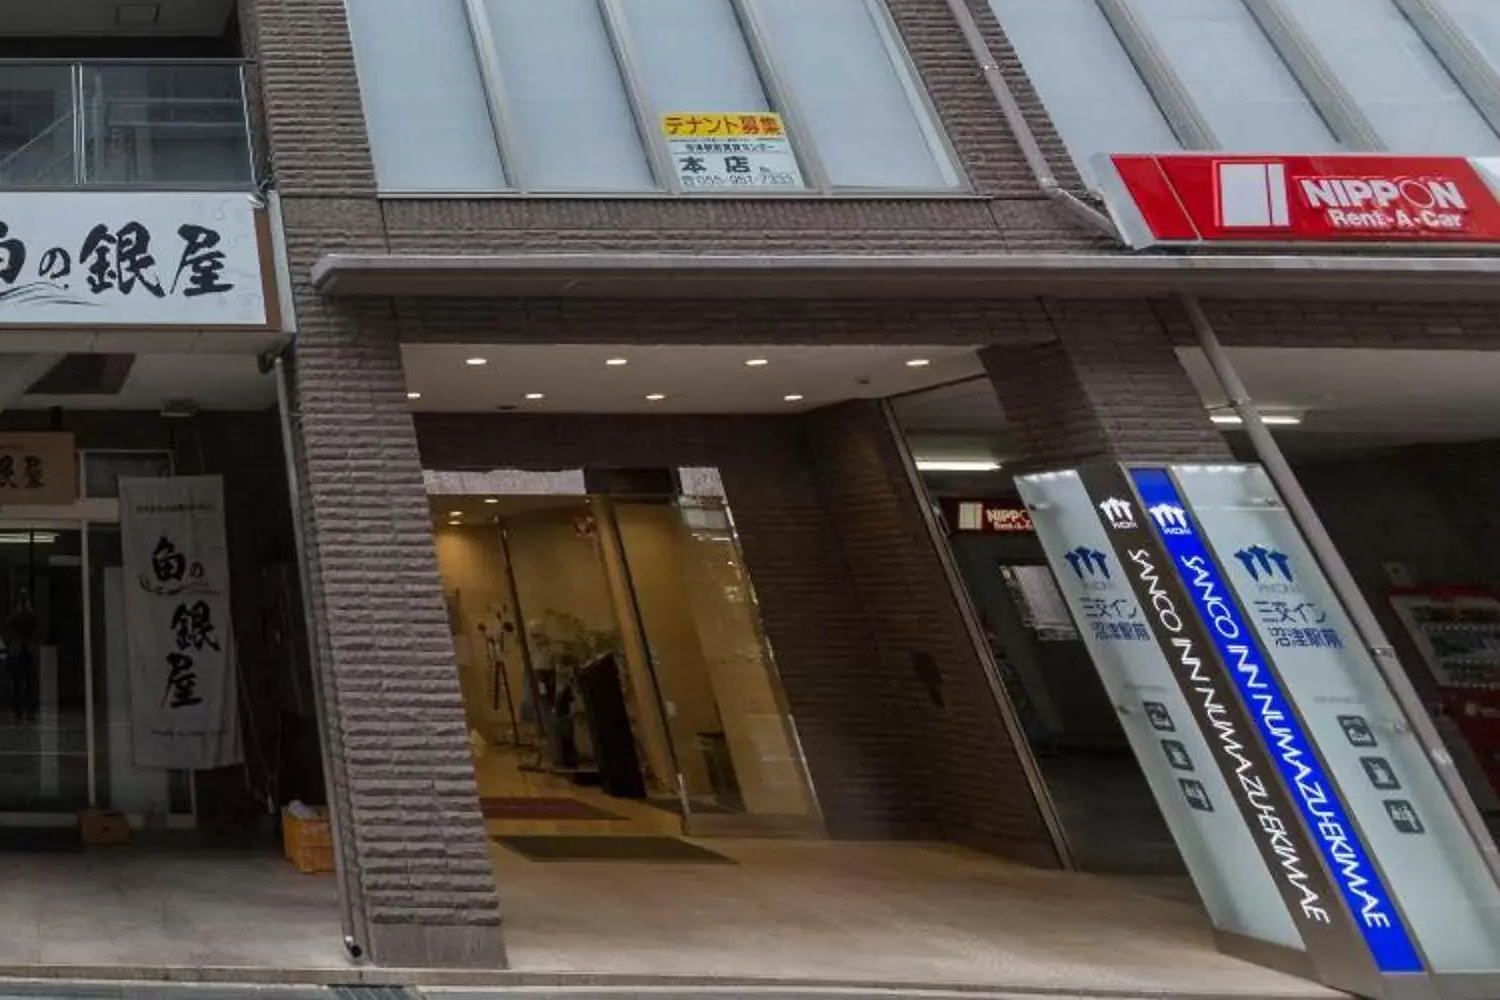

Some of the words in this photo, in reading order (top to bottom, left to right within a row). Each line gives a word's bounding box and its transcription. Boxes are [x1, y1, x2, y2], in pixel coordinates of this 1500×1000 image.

[664, 115, 781, 135] テナント募集
[679, 155, 751, 173] 本店
[1300, 179, 1467, 210] NIPPON
[1128, 548, 1182, 638] SANCO
[1172, 636, 1207, 682] INN
[1181, 555, 1239, 640] SANCO
[1228, 640, 1268, 689] INN
[1253, 599, 1327, 623] 三交イン
